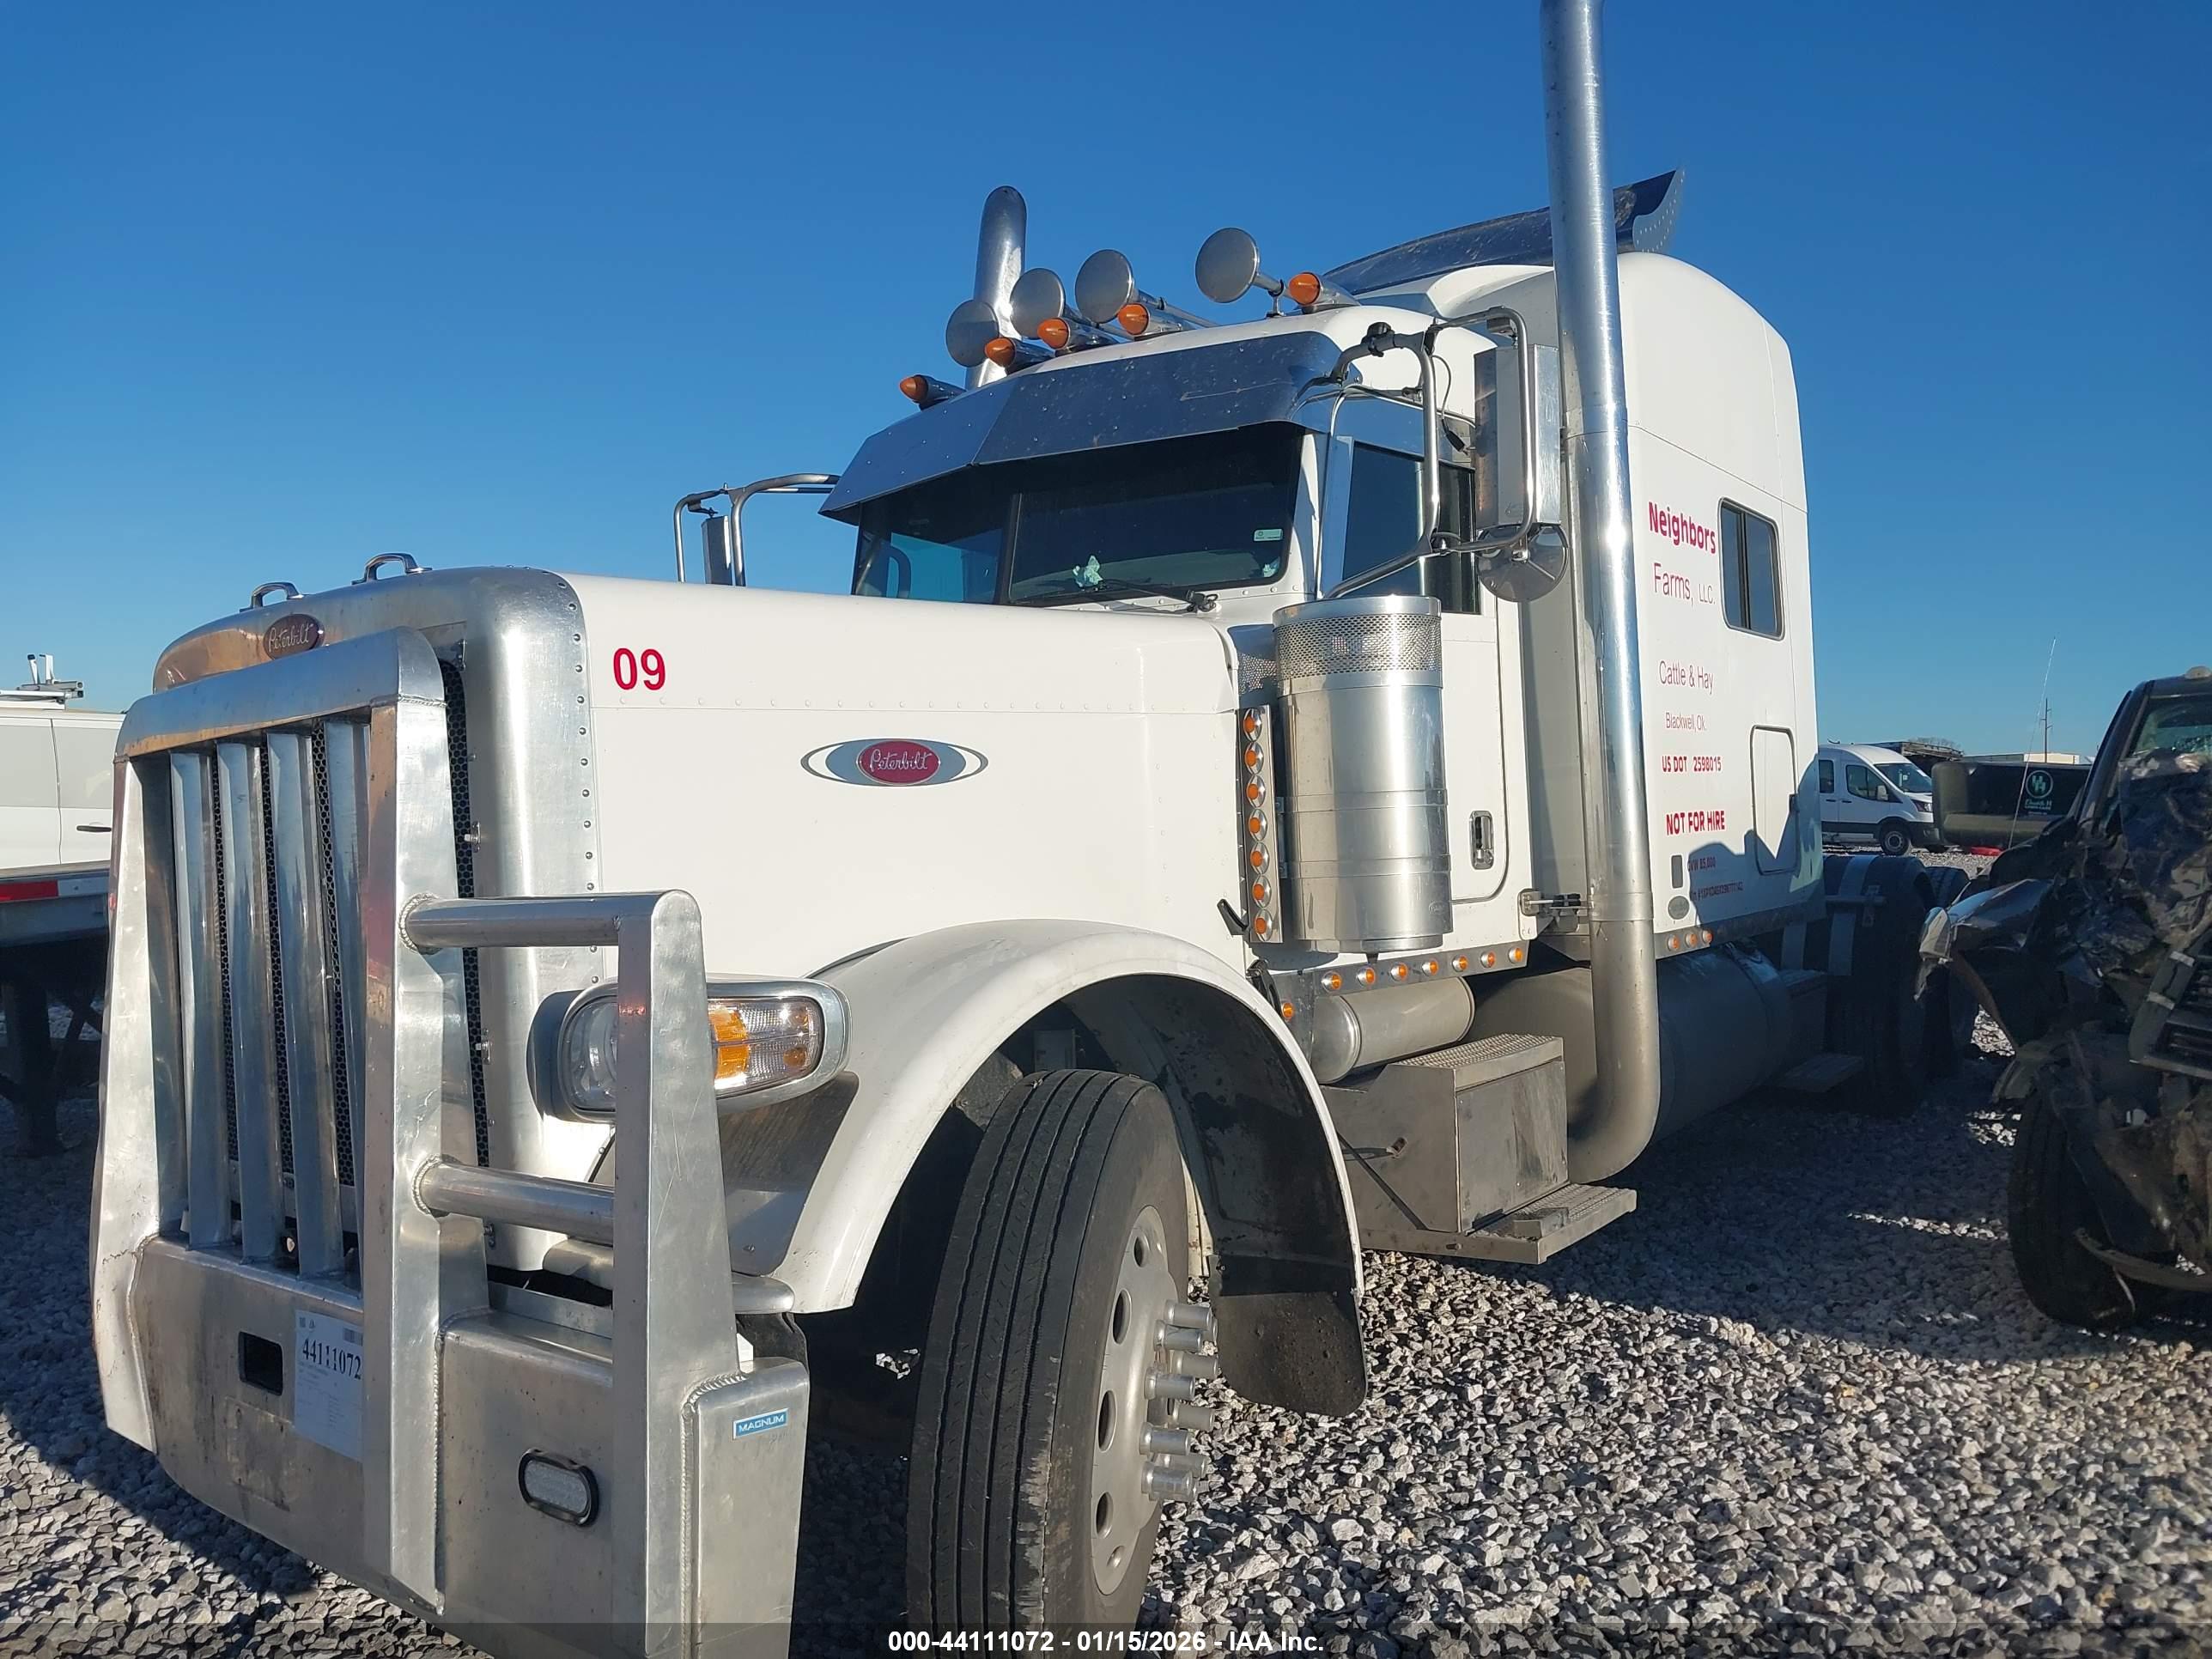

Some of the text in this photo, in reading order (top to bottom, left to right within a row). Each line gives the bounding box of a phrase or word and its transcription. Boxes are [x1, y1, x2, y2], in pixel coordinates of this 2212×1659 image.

[1648, 501, 1716, 554] Neighbors
[1654, 562, 1694, 607] Farms,
[268, 622, 314, 653] Peterbilt
[612, 647, 665, 690] 09
[1658, 660, 1714, 695] Cattle & Hay
[869, 748, 933, 774] Peterbilt
[1662, 756, 1722, 772] US DOT 2598015
[1666, 810, 1725, 836] NOT FOR HIRE
[302, 1337, 362, 1380] 44111072
[738, 1414, 784, 1433] MAGNUM
